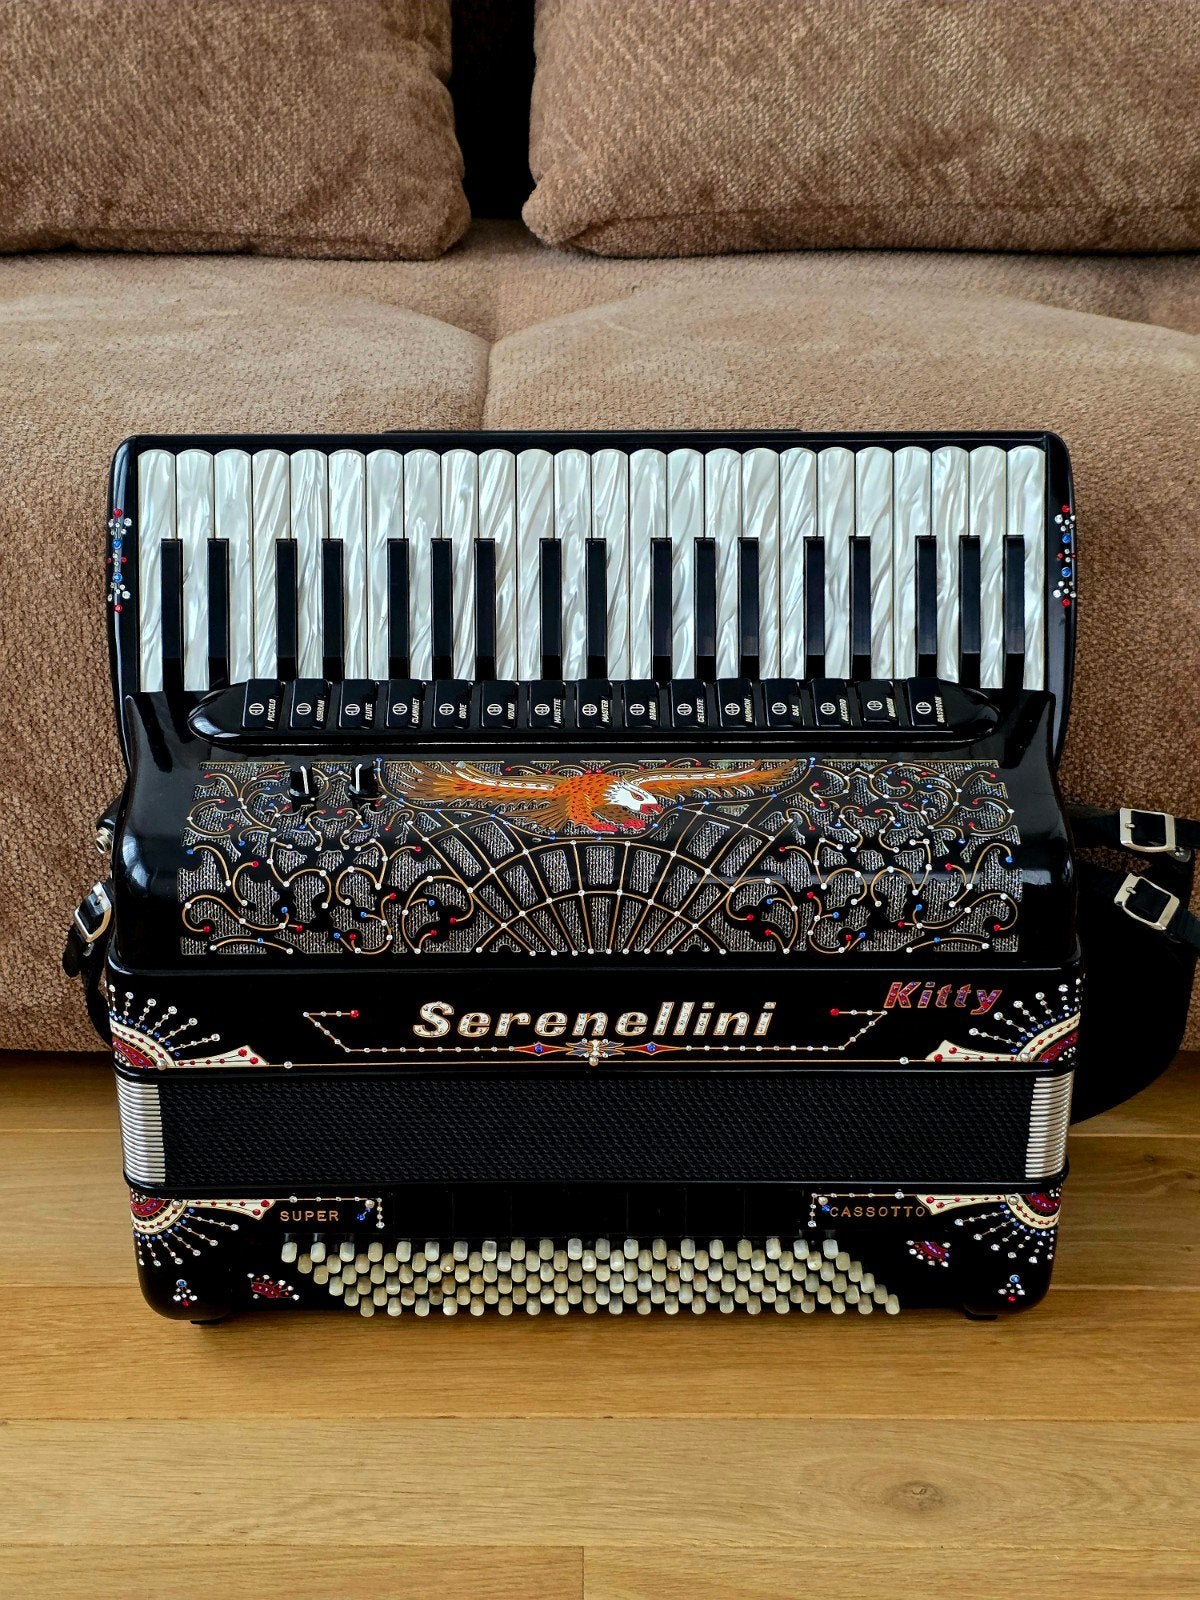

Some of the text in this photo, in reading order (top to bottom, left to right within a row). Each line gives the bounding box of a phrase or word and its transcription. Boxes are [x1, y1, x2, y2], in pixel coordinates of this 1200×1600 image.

[601, 700, 609, 722] MASTER
[883, 980, 1003, 1016] Kitty
[412, 1000, 777, 1039] Serenellini
[279, 1210, 340, 1222] SUPER
[829, 1206, 926, 1218] CASSOTTO
